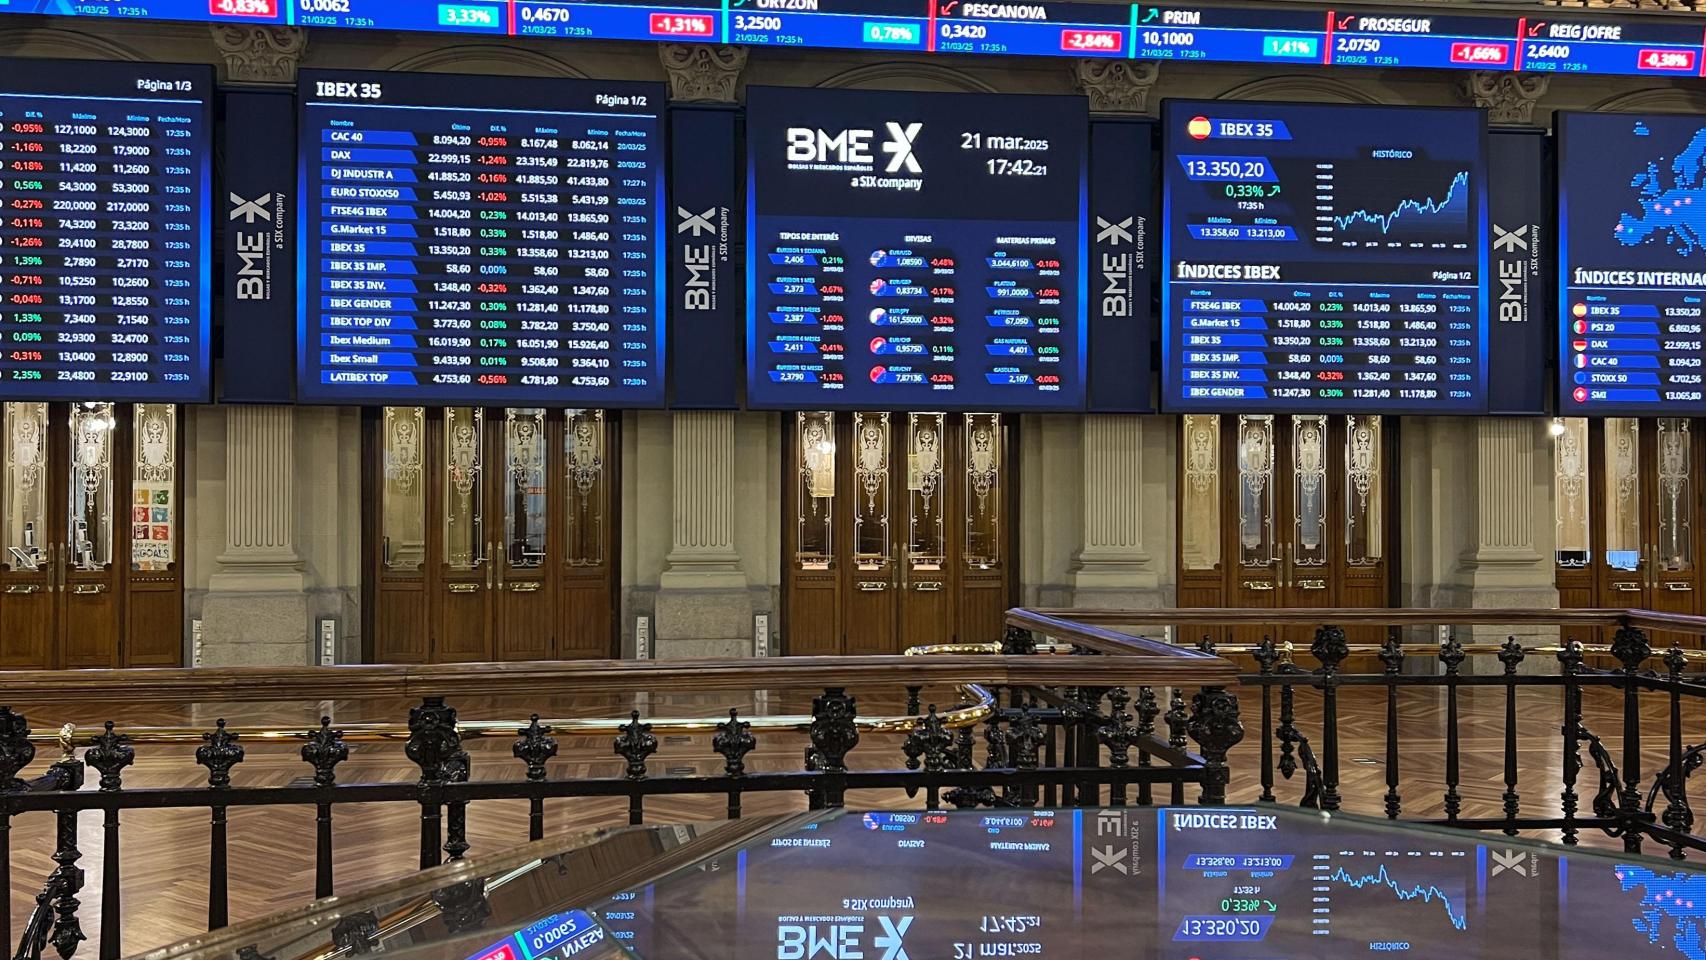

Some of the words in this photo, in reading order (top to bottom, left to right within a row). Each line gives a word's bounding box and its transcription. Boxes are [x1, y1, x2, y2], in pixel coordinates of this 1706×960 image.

[218, 0, 269, 13] -0,83%
[301, 0, 350, 12] 0,0062
[447, 9, 490, 24] 3,33%
[964, 4, 1046, 20] PESCANOVA
[302, 16, 337, 24] 21/03/25
[345, 18, 367, 26] 17:35
[368, 18, 374, 26] h
[522, 7, 569, 22] 0,4670
[658, 18, 705, 32] -1,31%
[1164, 11, 1200, 24] PRIM
[735, 16, 781, 30] 3,2500
[871, 26, 912, 41] 0,78%
[1359, 18, 1430, 32] PROSEGUR
[942, 24, 986, 38] 0,3420
[1069, 34, 1114, 48] -2,84%
[1550, 25, 1581, 38] REIG
[1582, 26, 1621, 40] JOFRE
[1143, 32, 1193, 45] 10,1000
[1272, 40, 1310, 54] 1,41%
[1337, 38, 1380, 52] 2,0750
[1458, 47, 1501, 61] -1,66%
[1527, 45, 1569, 58] 2,6400
[137, 80, 172, 91] Página
[175, 81, 191, 91] 1/3
[317, 82, 357, 97] IBEX
[361, 83, 381, 98] 35
[596, 95, 629, 106] Página
[631, 96, 646, 105] 1/2
[12, 124, 43, 132] -0,95%
[55, 125, 96, 134] 127,1000
[108, 127, 149, 136] 124,3000
[1221, 123, 1253, 135] IBEX
[1256, 124, 1273, 136] 35
[331, 132, 349, 141] CAC
[351, 133, 362, 141] 40
[961, 133, 980, 148] 21
[787, 128, 873, 162] BME
[331, 151, 350, 159] DAX
[429, 154, 470, 164] 22.999,15
[478, 156, 506, 164] -1,24%
[516, 157, 558, 166] 23.315,49
[567, 159, 608, 168] 22.819,76
[1373, 150, 1412, 158] HISTÓRICO
[331, 169, 341, 179] DJ
[343, 170, 384, 178] INDUSTR
[1188, 161, 1264, 177] 13.350,20
[851, 177, 858, 186] a
[860, 176, 876, 187] SIX
[878, 178, 922, 190] company
[331, 188, 357, 196] EURO
[359, 189, 399, 198] STOXX50
[434, 191, 470, 200] 5.450,93
[478, 193, 506, 201] -1,02%
[521, 194, 558, 203] 5.515,38
[572, 195, 608, 205] 5.431,99
[1226, 185, 1263, 197] 0,33%
[11, 200, 42, 208] -0,27%
[54, 201, 96, 210] 220,0000
[107, 202, 149, 212] 217,0000
[276, 192, 286, 228] company
[331, 206, 364, 215] FTSE4G
[366, 207, 387, 216] IBEX
[721, 207, 729, 242] company
[275, 230, 283, 243] SIX
[1201, 228, 1239, 236] 13.358,60
[1248, 229, 1285, 237] 13.213,00
[331, 243, 352, 251] IBEX
[354, 244, 365, 252] 35
[429, 246, 470, 255] 13.350,20
[480, 247, 506, 255] 0,33%
[517, 248, 558, 257] 13.358,60
[568, 250, 608, 259] 13.213,00
[720, 243, 728, 255] SIX
[15, 257, 42, 265] 1,39%
[64, 257, 95, 266] 2,7890
[118, 259, 148, 267] 2,7170
[237, 232, 263, 299] BME
[785, 256, 804, 264] 2,406
[1178, 261, 1241, 278] ÍNDICES
[1244, 266, 1280, 279] IBEX
[1433, 272, 1460, 281] Página
[1575, 268, 1635, 284] ÍNDICES
[685, 245, 709, 309] BME
[1103, 253, 1126, 316] BME
[1500, 260, 1521, 321] BME
[331, 299, 352, 307] IBEX
[354, 300, 391, 308] GENDER
[1222, 302, 1240, 310] IBEX
[1273, 303, 1310, 311] 14.004,20
[1353, 304, 1390, 312] 14.013,40
[1400, 304, 1436, 313] 13.865,90
[1591, 306, 1609, 315] IBEX
[1610, 306, 1619, 315] 35
[1665, 308, 1701, 316] 13.350,20
[331, 317, 352, 326] IBEX
[353, 318, 372, 326] TOP
[374, 318, 391, 326] DIV
[1591, 323, 1604, 332] PSI
[1605, 323, 1614, 332] 20
[331, 336, 351, 344] Ibex
[353, 336, 390, 345] Medium
[1591, 340, 1608, 349] DAX
[1665, 341, 1701, 350] 22.999,15
[1591, 358, 1607, 366] CAC
[1608, 358, 1617, 366] 40
[13, 371, 41, 379] 2,35%
[58, 371, 95, 380] 23,4800
[111, 372, 148, 381] 22,9100
[331, 373, 370, 381] LATIBEX
[369, 373, 388, 382] TOP
[1591, 374, 1616, 382] STOXX
[1618, 374, 1627, 382] 50
[1191, 388, 1209, 396] IBEX
[1211, 388, 1244, 396] GENDER
[1273, 389, 1310, 397] 11.247,30
[1591, 391, 1606, 399] SMI
